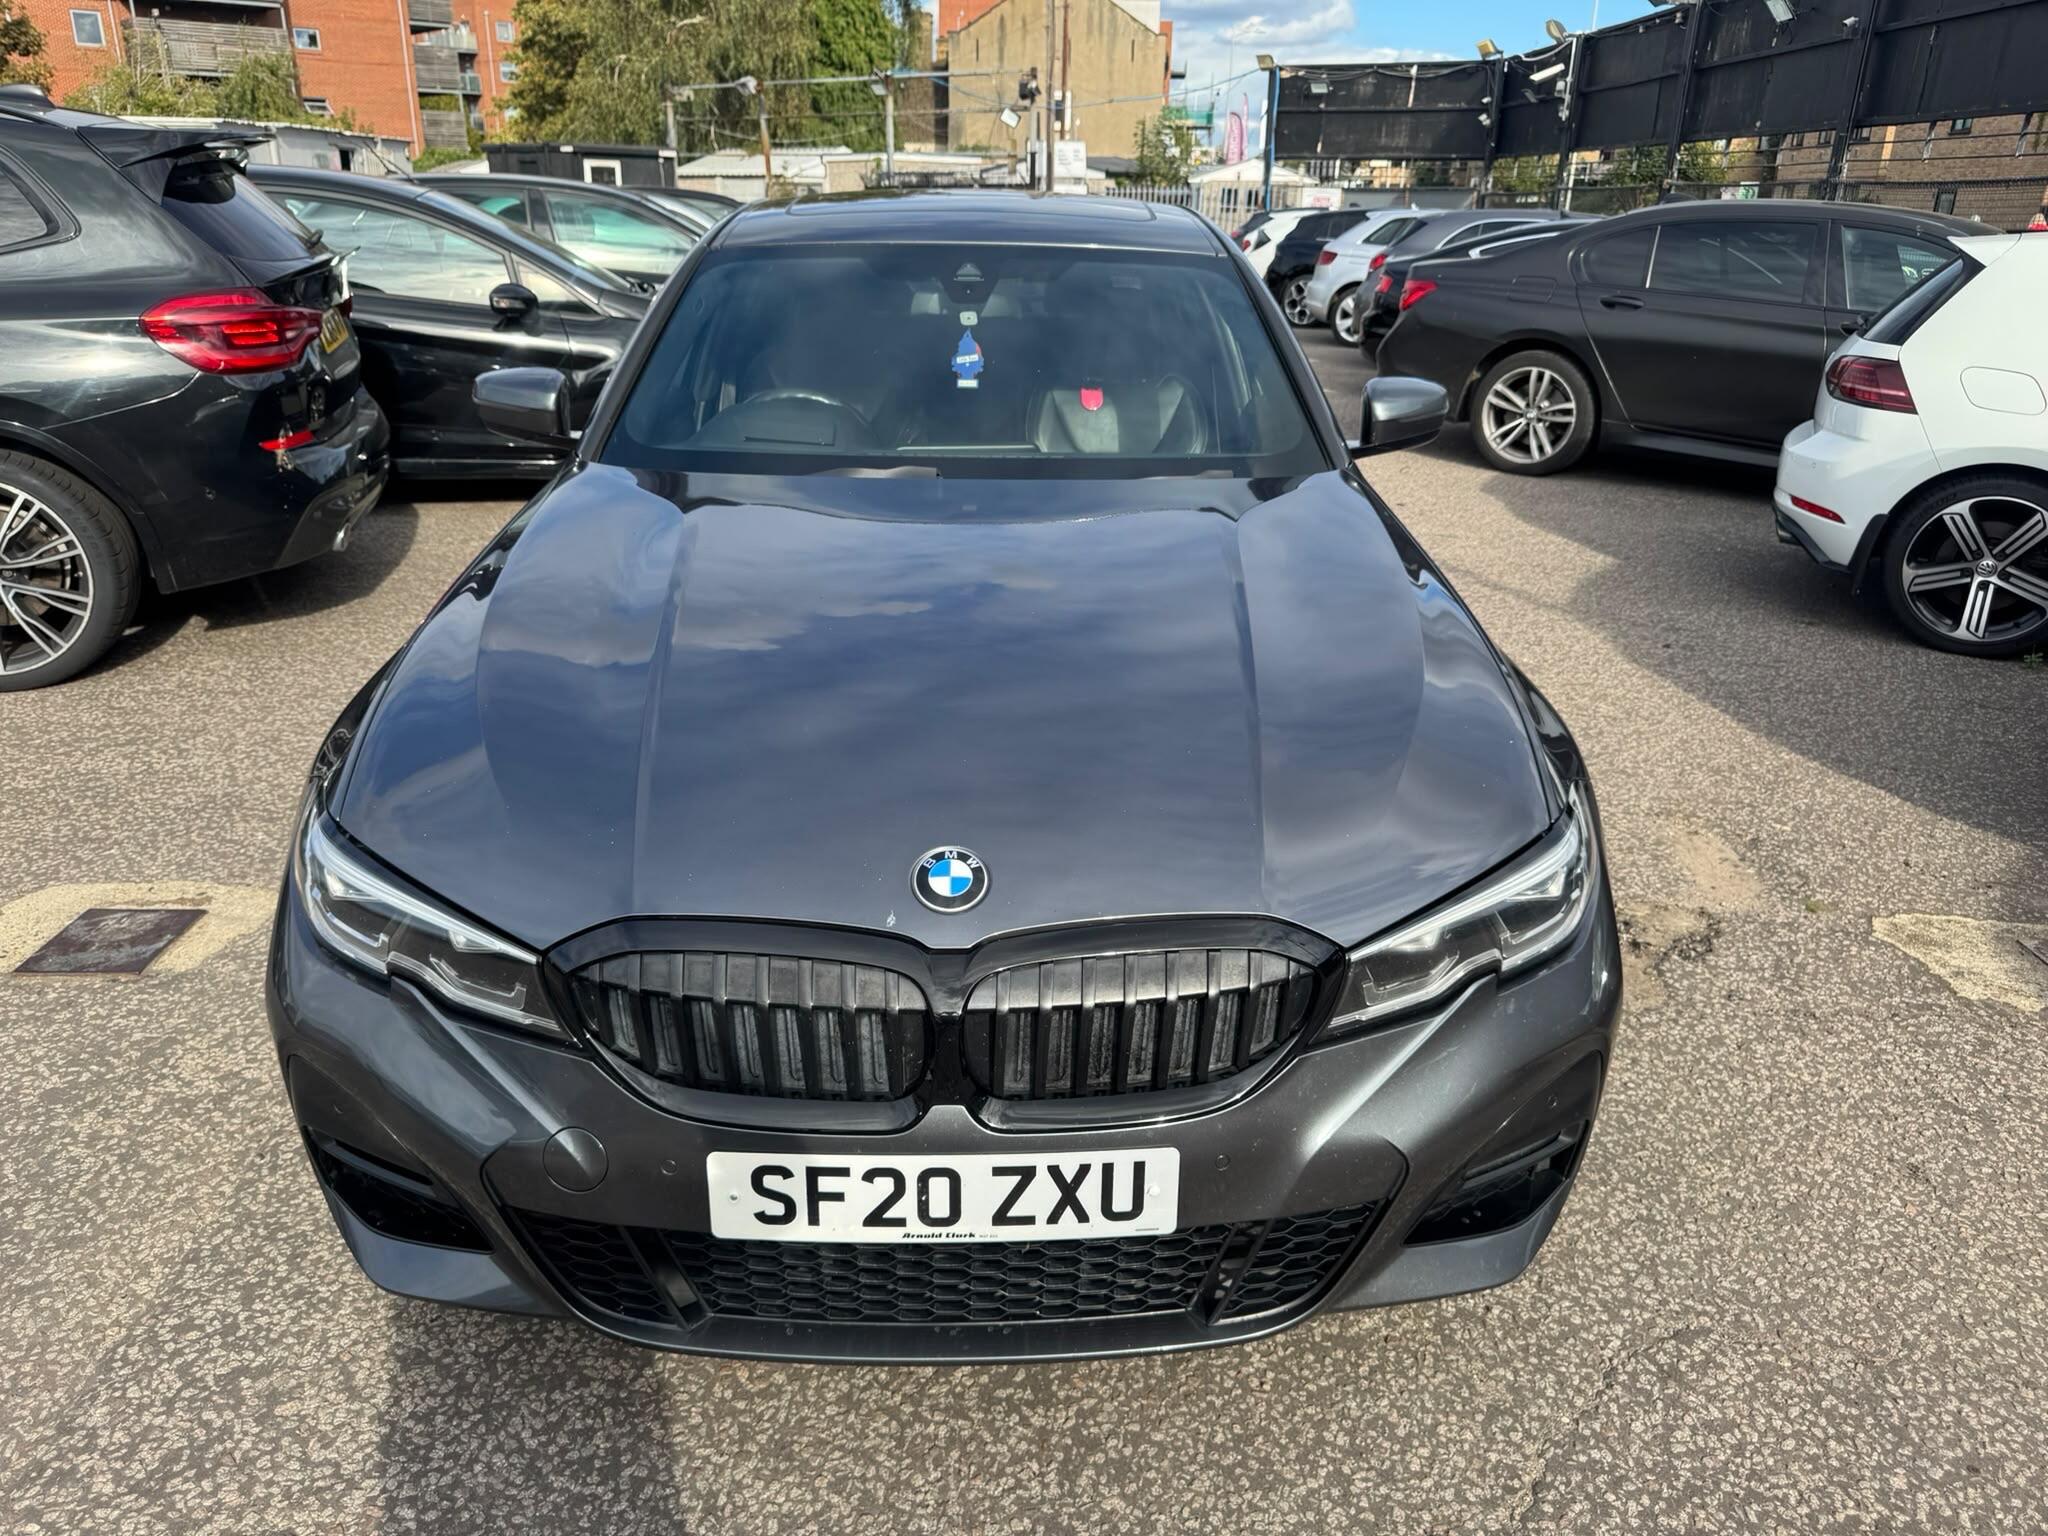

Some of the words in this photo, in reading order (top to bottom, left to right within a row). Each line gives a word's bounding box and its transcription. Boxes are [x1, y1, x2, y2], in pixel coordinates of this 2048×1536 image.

[923, 850, 980, 869] BMW
[750, 1164, 962, 1228] SF20
[991, 1160, 1146, 1226] ZXU
